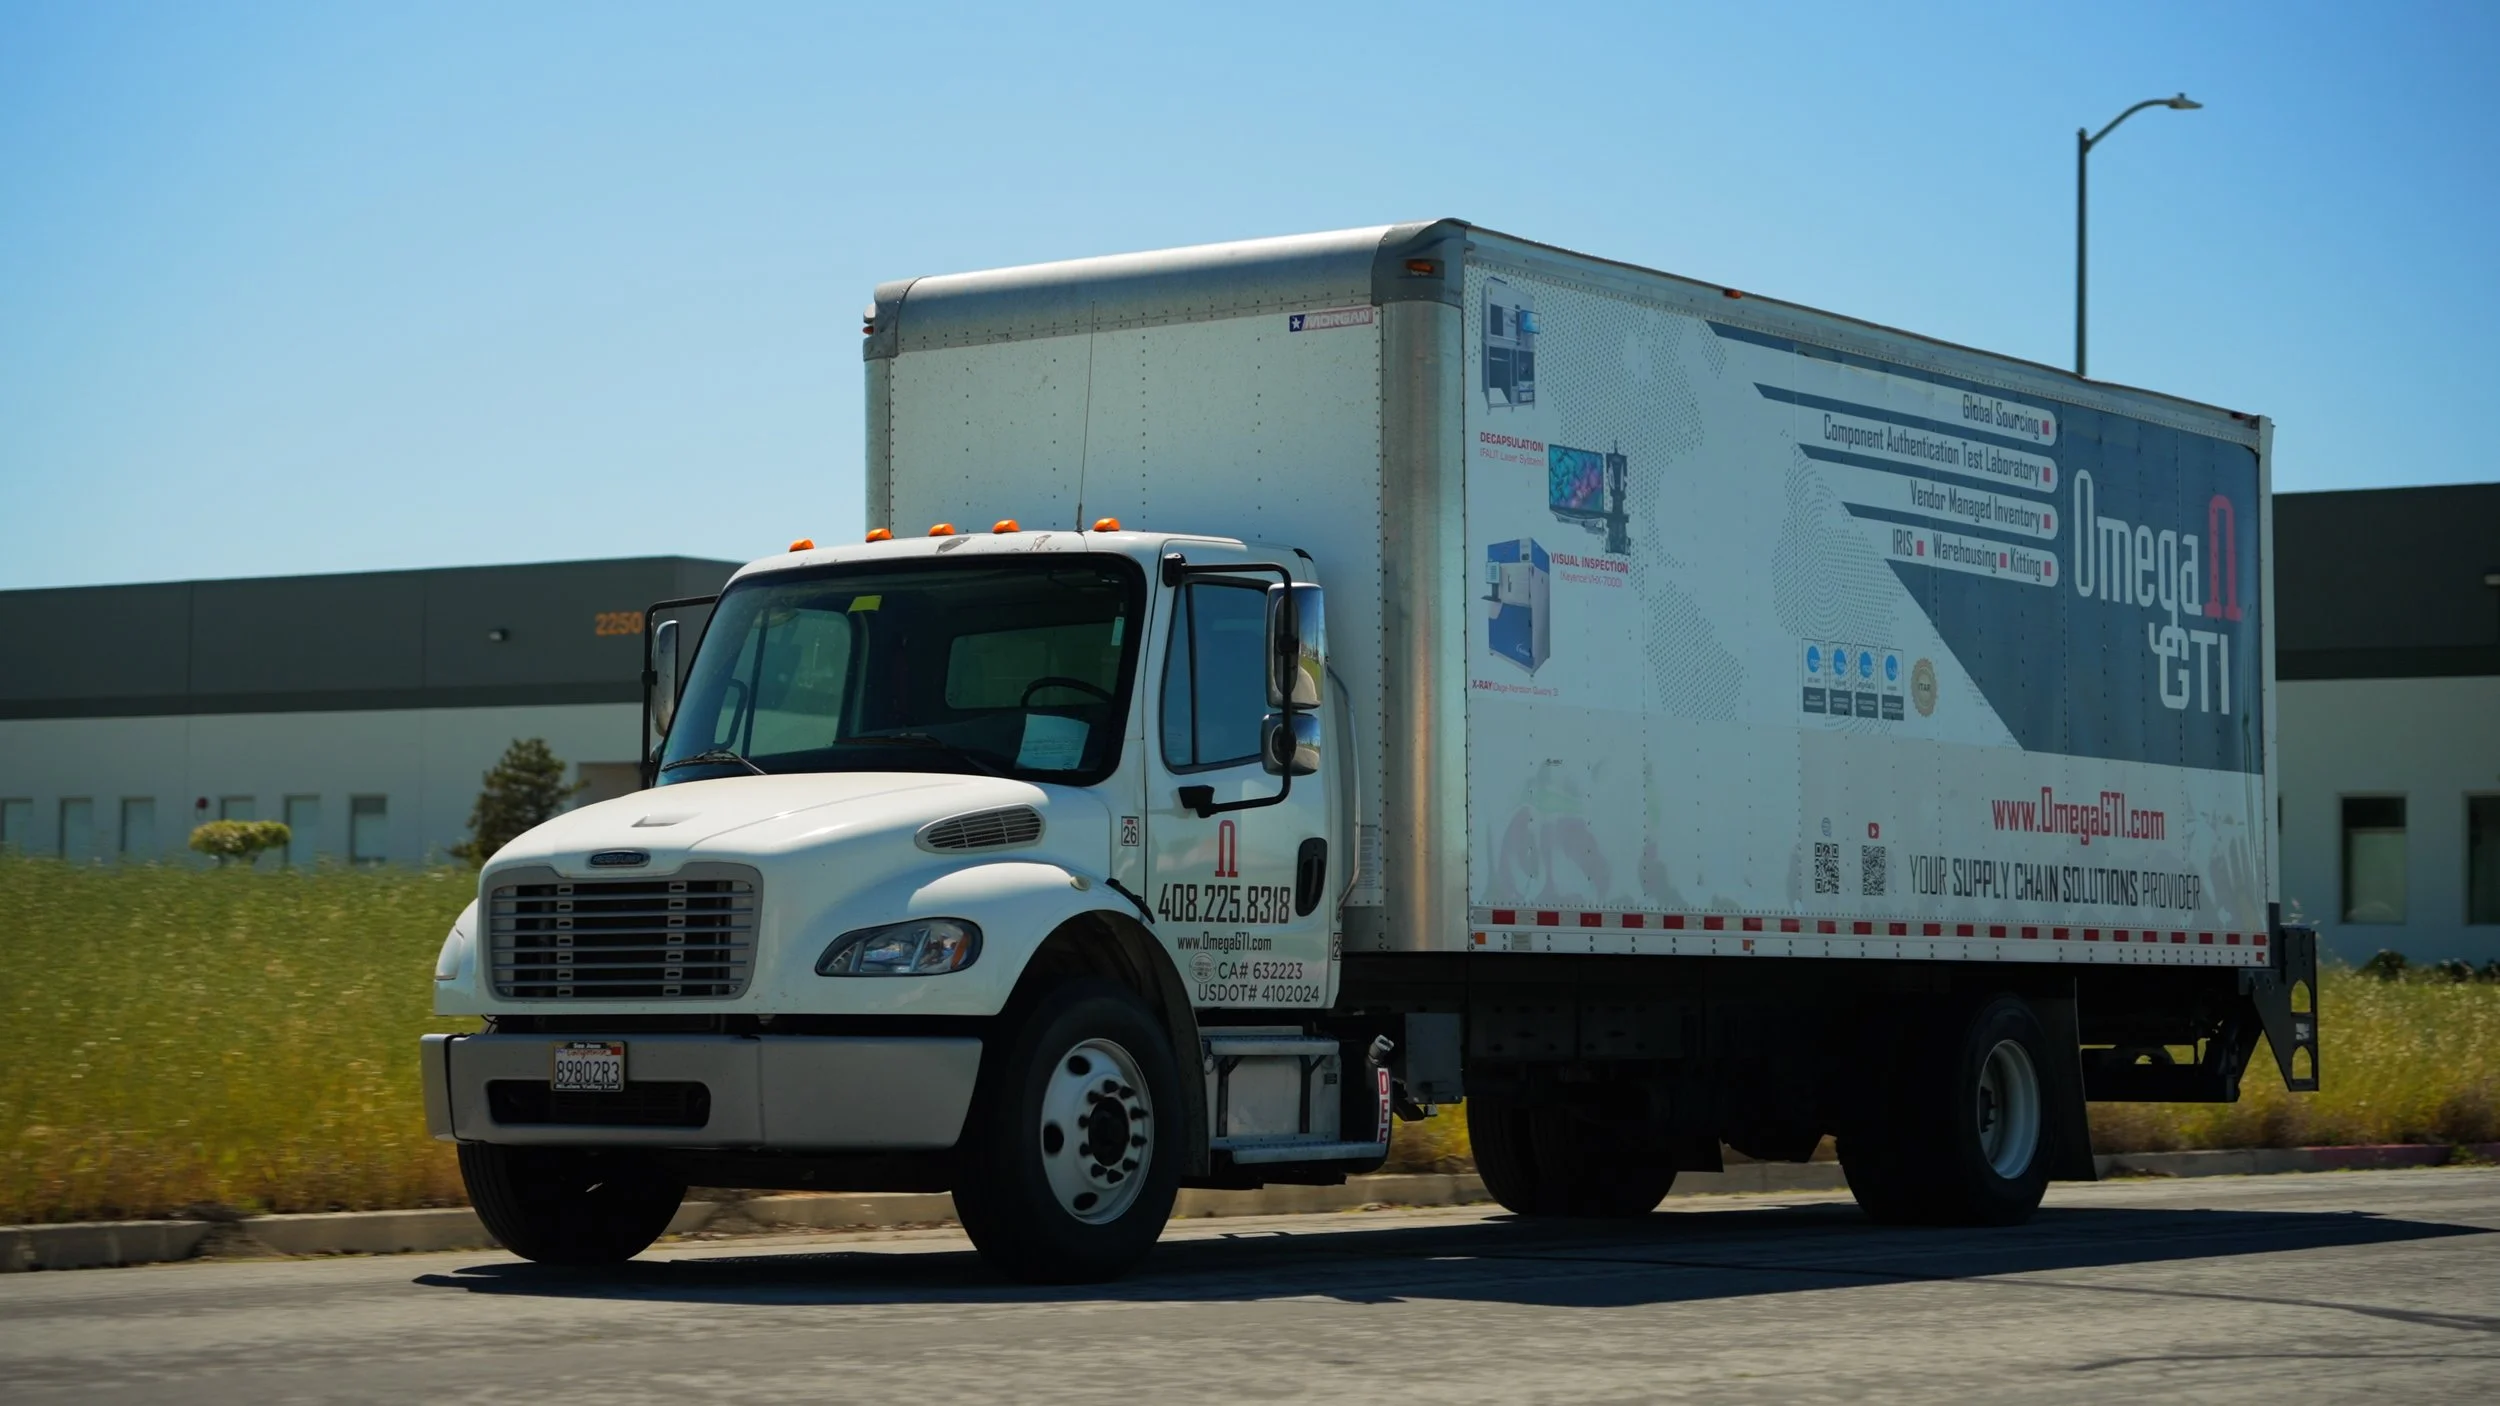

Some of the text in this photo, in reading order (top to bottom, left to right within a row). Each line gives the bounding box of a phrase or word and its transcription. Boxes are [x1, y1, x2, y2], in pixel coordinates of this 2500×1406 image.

[1304, 309, 1369, 329] MORGAN
[1963, 394, 2040, 440] Global Sourcing
[1480, 431, 1544, 453] DECAPSULATION
[1824, 413, 2040, 487] Component Authentication Test Laboratory
[1910, 479, 2041, 535] Vendor Managed Inventory
[1551, 552, 1629, 574] VISUAL INSPECTION
[1892, 528, 2041, 583] IRIS Warehousing Kitting
[2074, 469, 2203, 648] Omega
[594, 611, 643, 636] 2250
[2159, 626, 2231, 715] GTI
[1472, 680, 1492, 690] X-RAY
[1991, 786, 2165, 845] www.OmegaGTI.com
[1123, 826, 1137, 844] 26
[1909, 854, 2201, 911] YOUR SUPPLY CHAIN SOLUTIONS PROVIDER
[1158, 883, 1290, 924] 408.225.8318
[1177, 931, 1272, 954] www.OmegaGTI.com
[1218, 962, 1248, 980] CA#
[1253, 962, 1303, 980] 632223
[1198, 984, 1319, 1002] USDOT# 4102024
[556, 1060, 620, 1083] 89802R3
